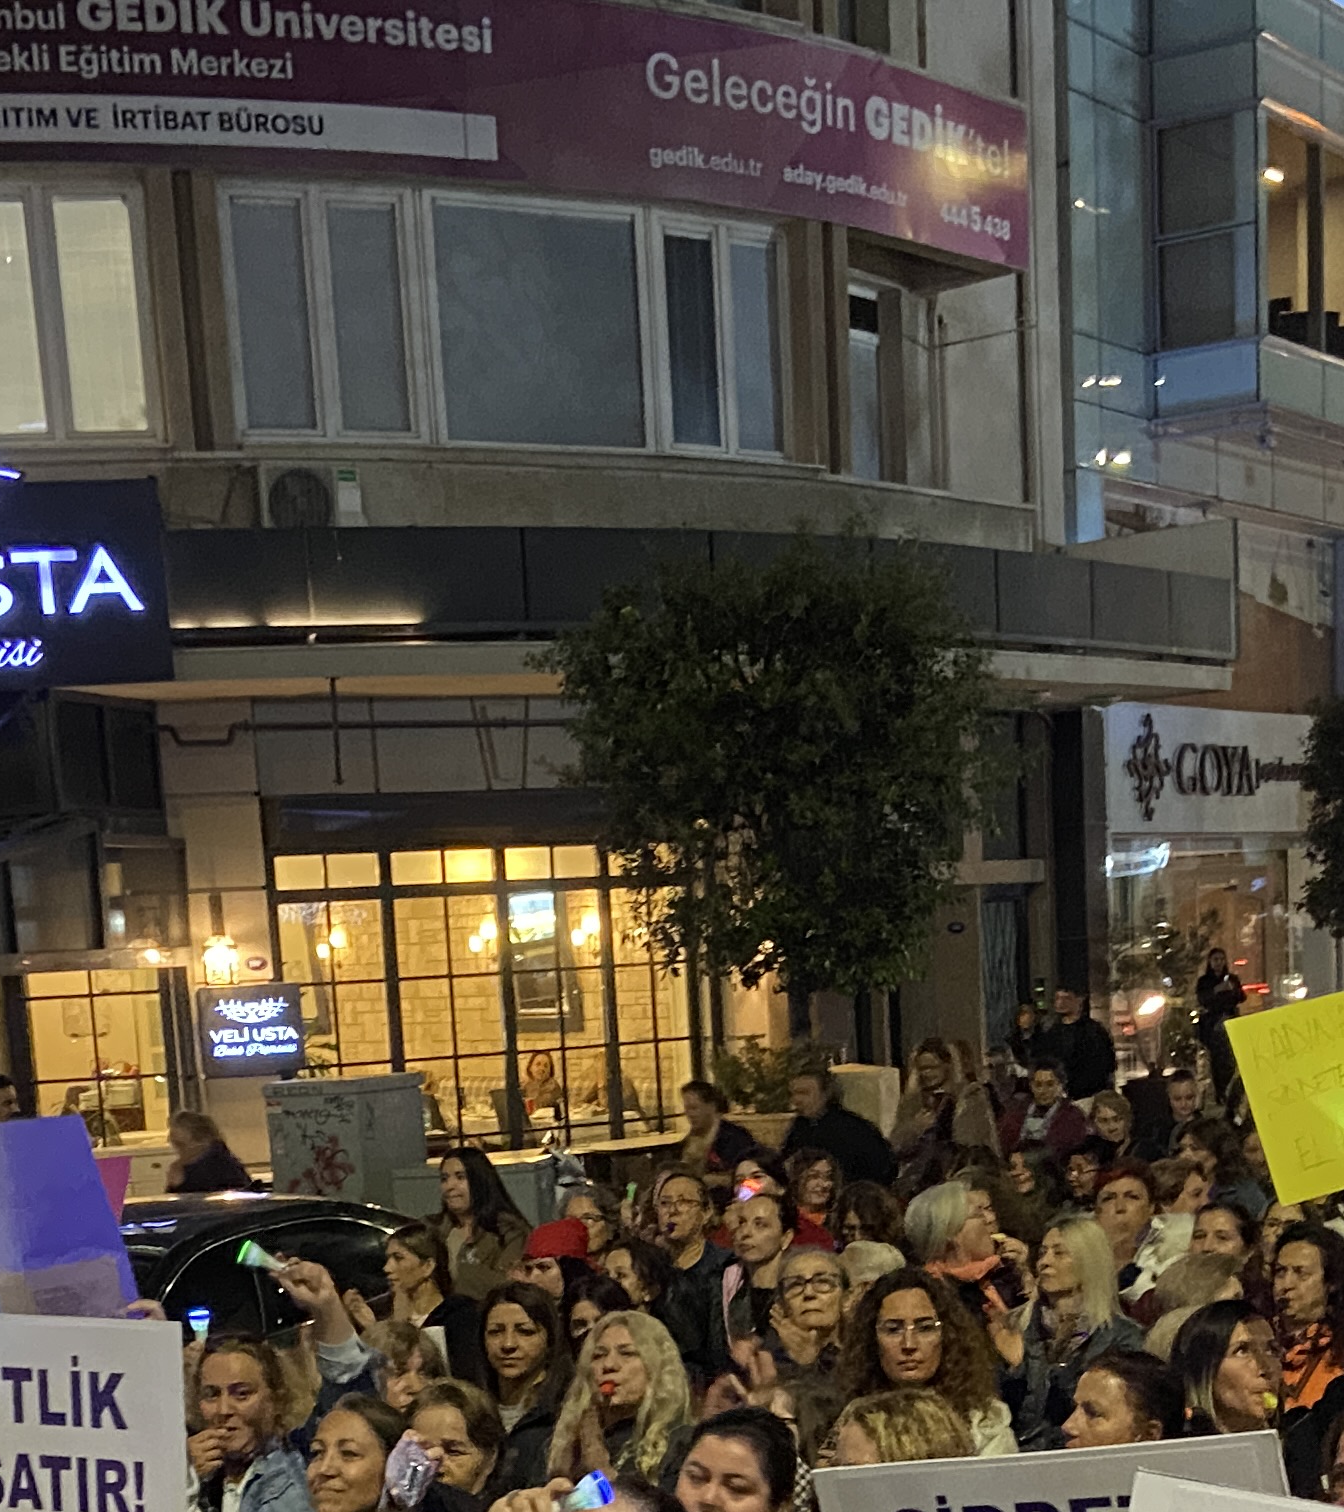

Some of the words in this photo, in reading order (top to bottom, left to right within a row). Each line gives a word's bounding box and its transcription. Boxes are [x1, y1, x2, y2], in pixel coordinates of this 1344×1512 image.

[59, 44, 162, 80] Eğitim
[170, 48, 293, 80] Merkezi
[645, 52, 855, 135] Geleceğin
[65, 107, 100, 129] VE
[112, 102, 211, 131] İRTİBAT
[218, 107, 325, 136] BÜROSU
[649, 145, 763, 177] gedik.edu.tr
[1170, 742, 1255, 797] GOYA
[252, 1026, 299, 1042] USTA
